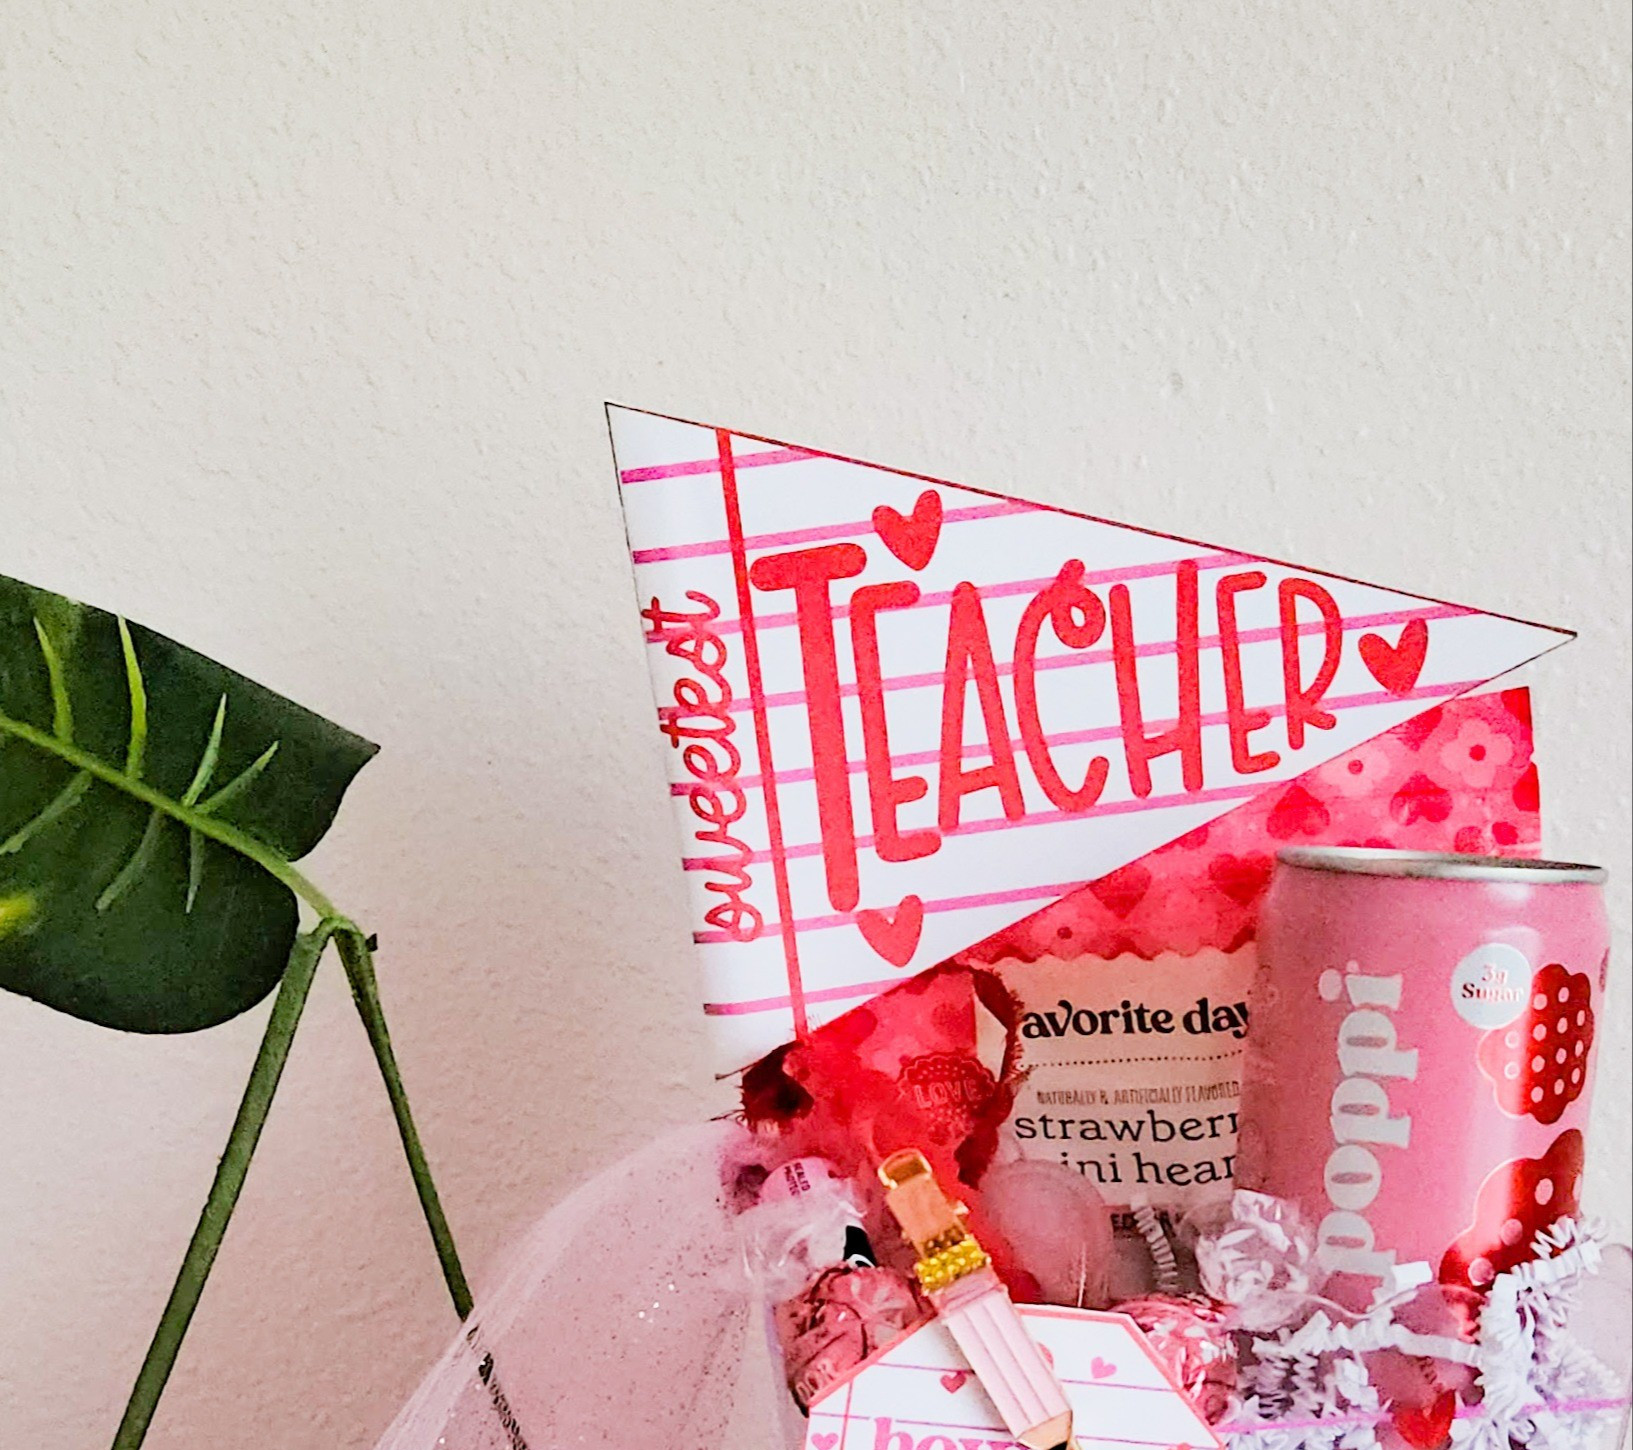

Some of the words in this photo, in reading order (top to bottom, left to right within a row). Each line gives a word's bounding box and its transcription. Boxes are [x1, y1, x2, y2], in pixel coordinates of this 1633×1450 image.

[750, 542, 1343, 912] TEACHER
[641, 590, 763, 942] sweetest
[1462, 983, 1524, 1002] Sugar
[1021, 1000, 1176, 1039] avorite
[914, 1079, 982, 1109] LOVE
[1015, 1109, 1239, 1142] strawberr
[1317, 964, 1419, 1277] poppi
[1060, 1152, 1122, 1183] ini
[1132, 1152, 1237, 1186] hear
